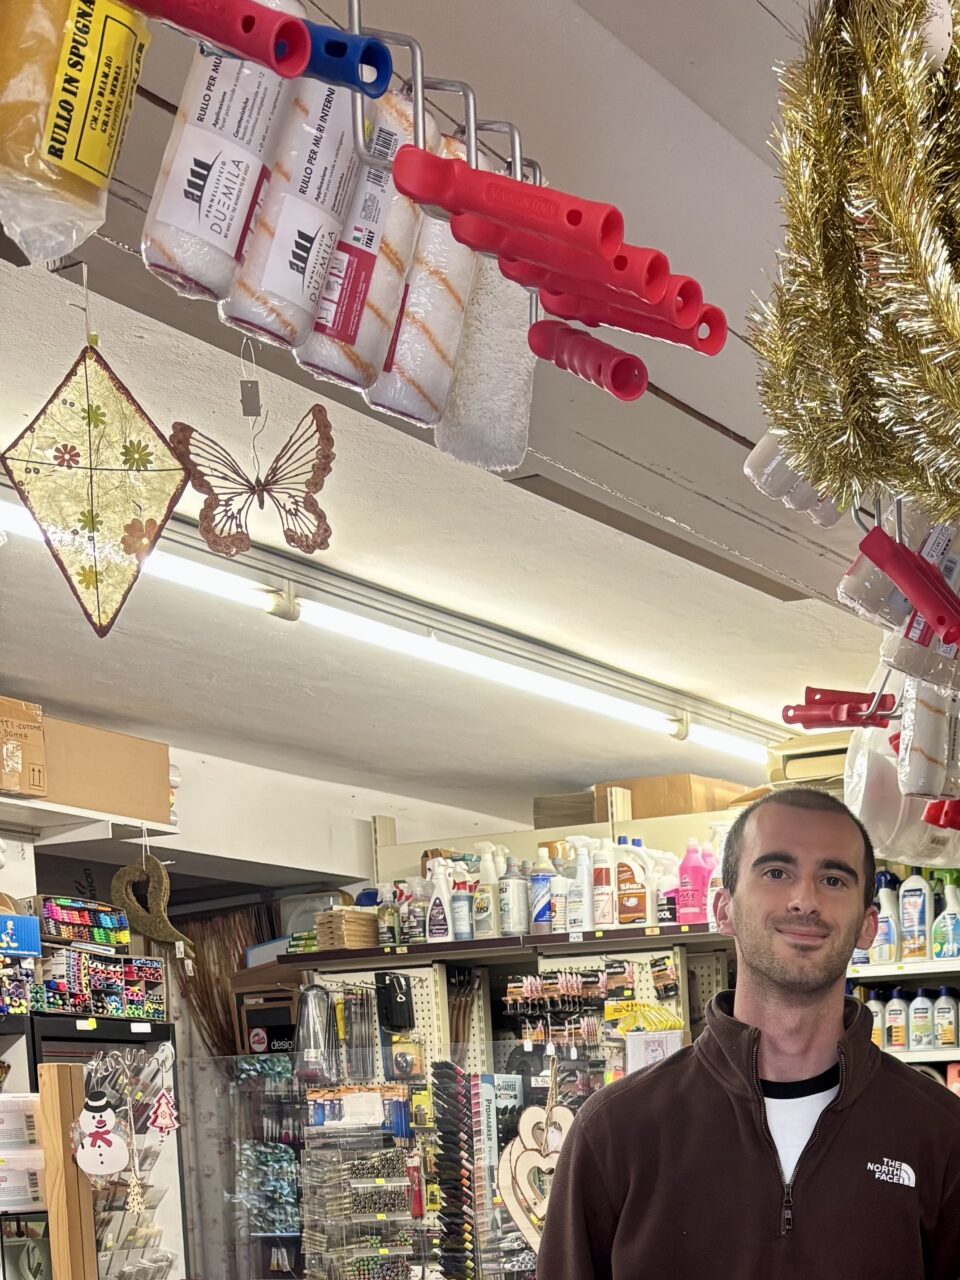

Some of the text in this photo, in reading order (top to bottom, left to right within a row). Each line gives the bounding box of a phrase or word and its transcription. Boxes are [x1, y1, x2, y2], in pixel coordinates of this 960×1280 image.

[48, 0, 97, 160] RULLO IN SPUGNA
[197, 93, 211, 122] RULLO
[207, 75, 218, 93] PER
[212, 91, 228, 128] Applicazione
[299, 166, 313, 195] RULLO
[307, 148, 318, 166] PER
[319, 87, 336, 124] INTERNI
[205, 160, 227, 219] PENNELLIFICIO
[315, 166, 328, 202] Applicazione
[365, 229, 375, 249] ITALY
[867, 1161, 900, 1177] NORTH
[875, 1172, 901, 1184] FACE
[883, 1157, 902, 1169] THE
